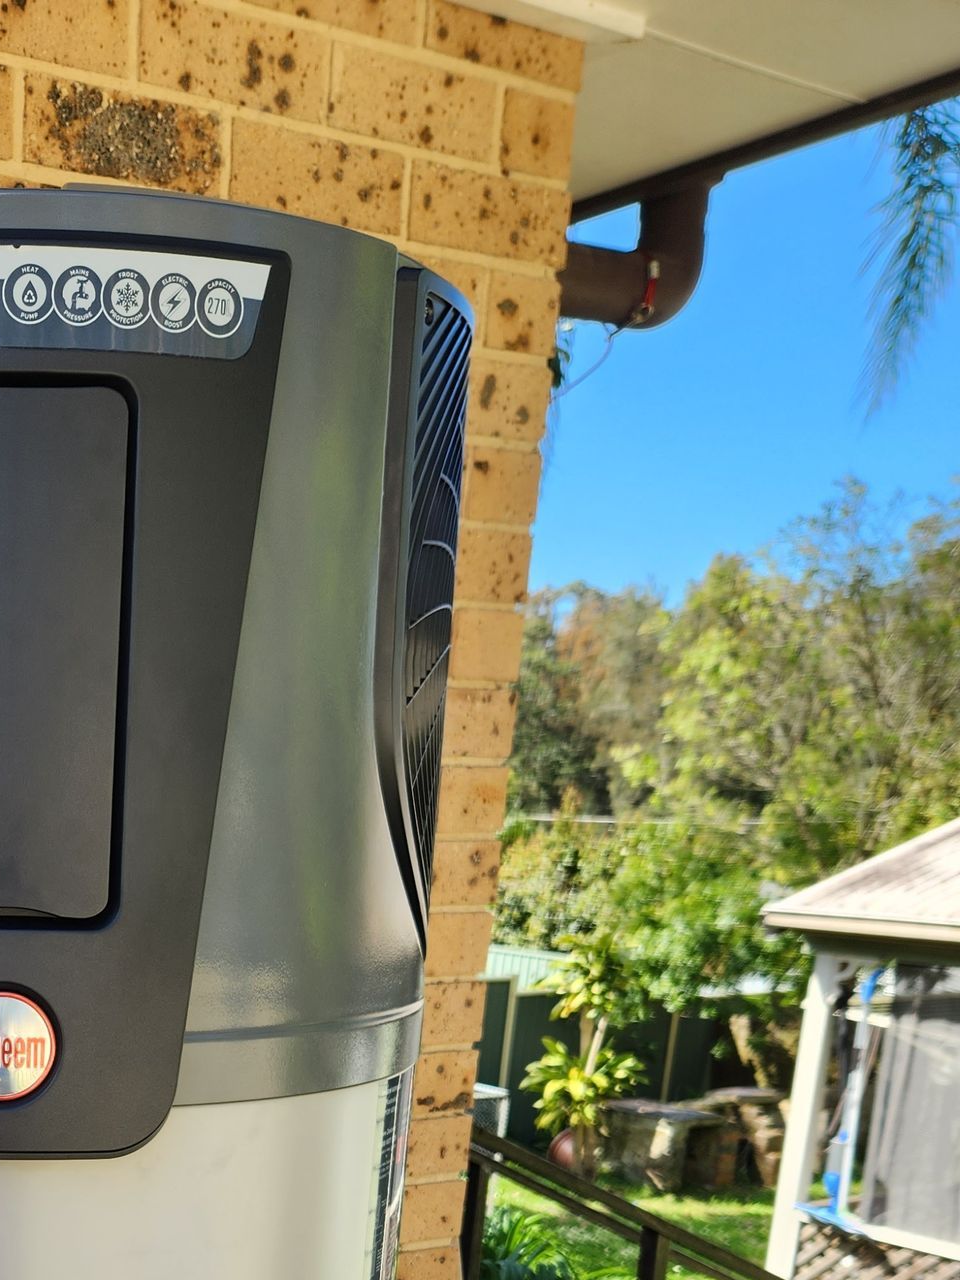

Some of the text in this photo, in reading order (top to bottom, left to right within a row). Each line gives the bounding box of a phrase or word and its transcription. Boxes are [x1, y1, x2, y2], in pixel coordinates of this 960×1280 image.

[69, 269, 89, 277] MAINS
[118, 271, 138, 279] FROST
[161, 276, 189, 287] ELECTRIC
[207, 280, 235, 294] CAPACITY
[20, 312, 39, 320] PUMP
[63, 309, 93, 321] PRESSURE
[109, 308, 144, 324] PROTECTION
[164, 319, 183, 328] BOOST
